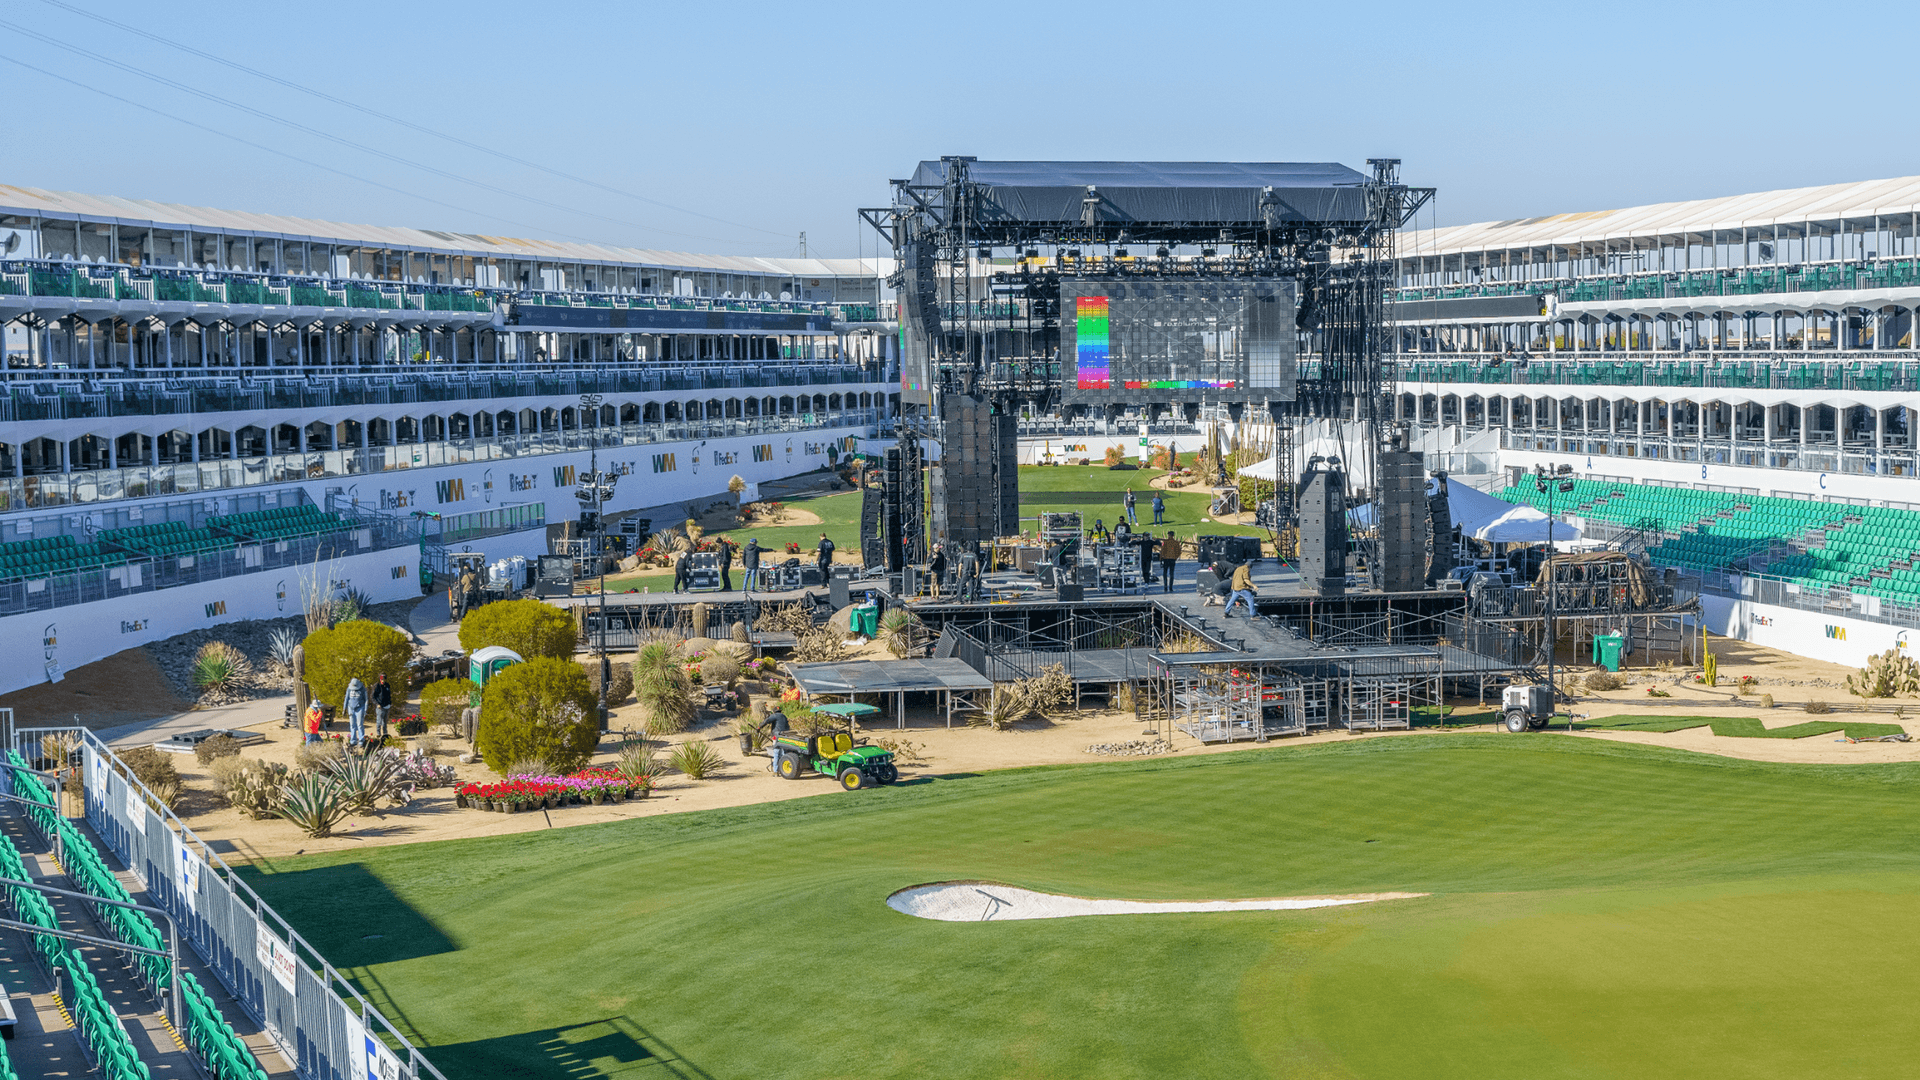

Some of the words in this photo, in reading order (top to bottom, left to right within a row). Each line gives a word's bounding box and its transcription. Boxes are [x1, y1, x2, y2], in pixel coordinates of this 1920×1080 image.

[719, 452, 733, 466] FedEx
[753, 444, 773, 462] WM
[652, 453, 677, 473] WM
[1587, 456, 1592, 469] A
[553, 465, 576, 488] WM
[1702, 465, 1707, 479] B
[515, 475, 532, 491] FedEx
[1820, 473, 1826, 489] C
[436, 478, 465, 504] WM
[387, 491, 408, 509] FedEx
[214, 502, 219, 516] R
[84, 516, 92, 534] Q
[391, 565, 407, 579] WM
[205, 600, 227, 618] WM
[126, 620, 142, 633] FedEx
[1755, 615, 1768, 626] FedEx
[1825, 624, 1847, 641] WM
[43, 637, 57, 646] WM
[379, 1053, 387, 1079] NO
